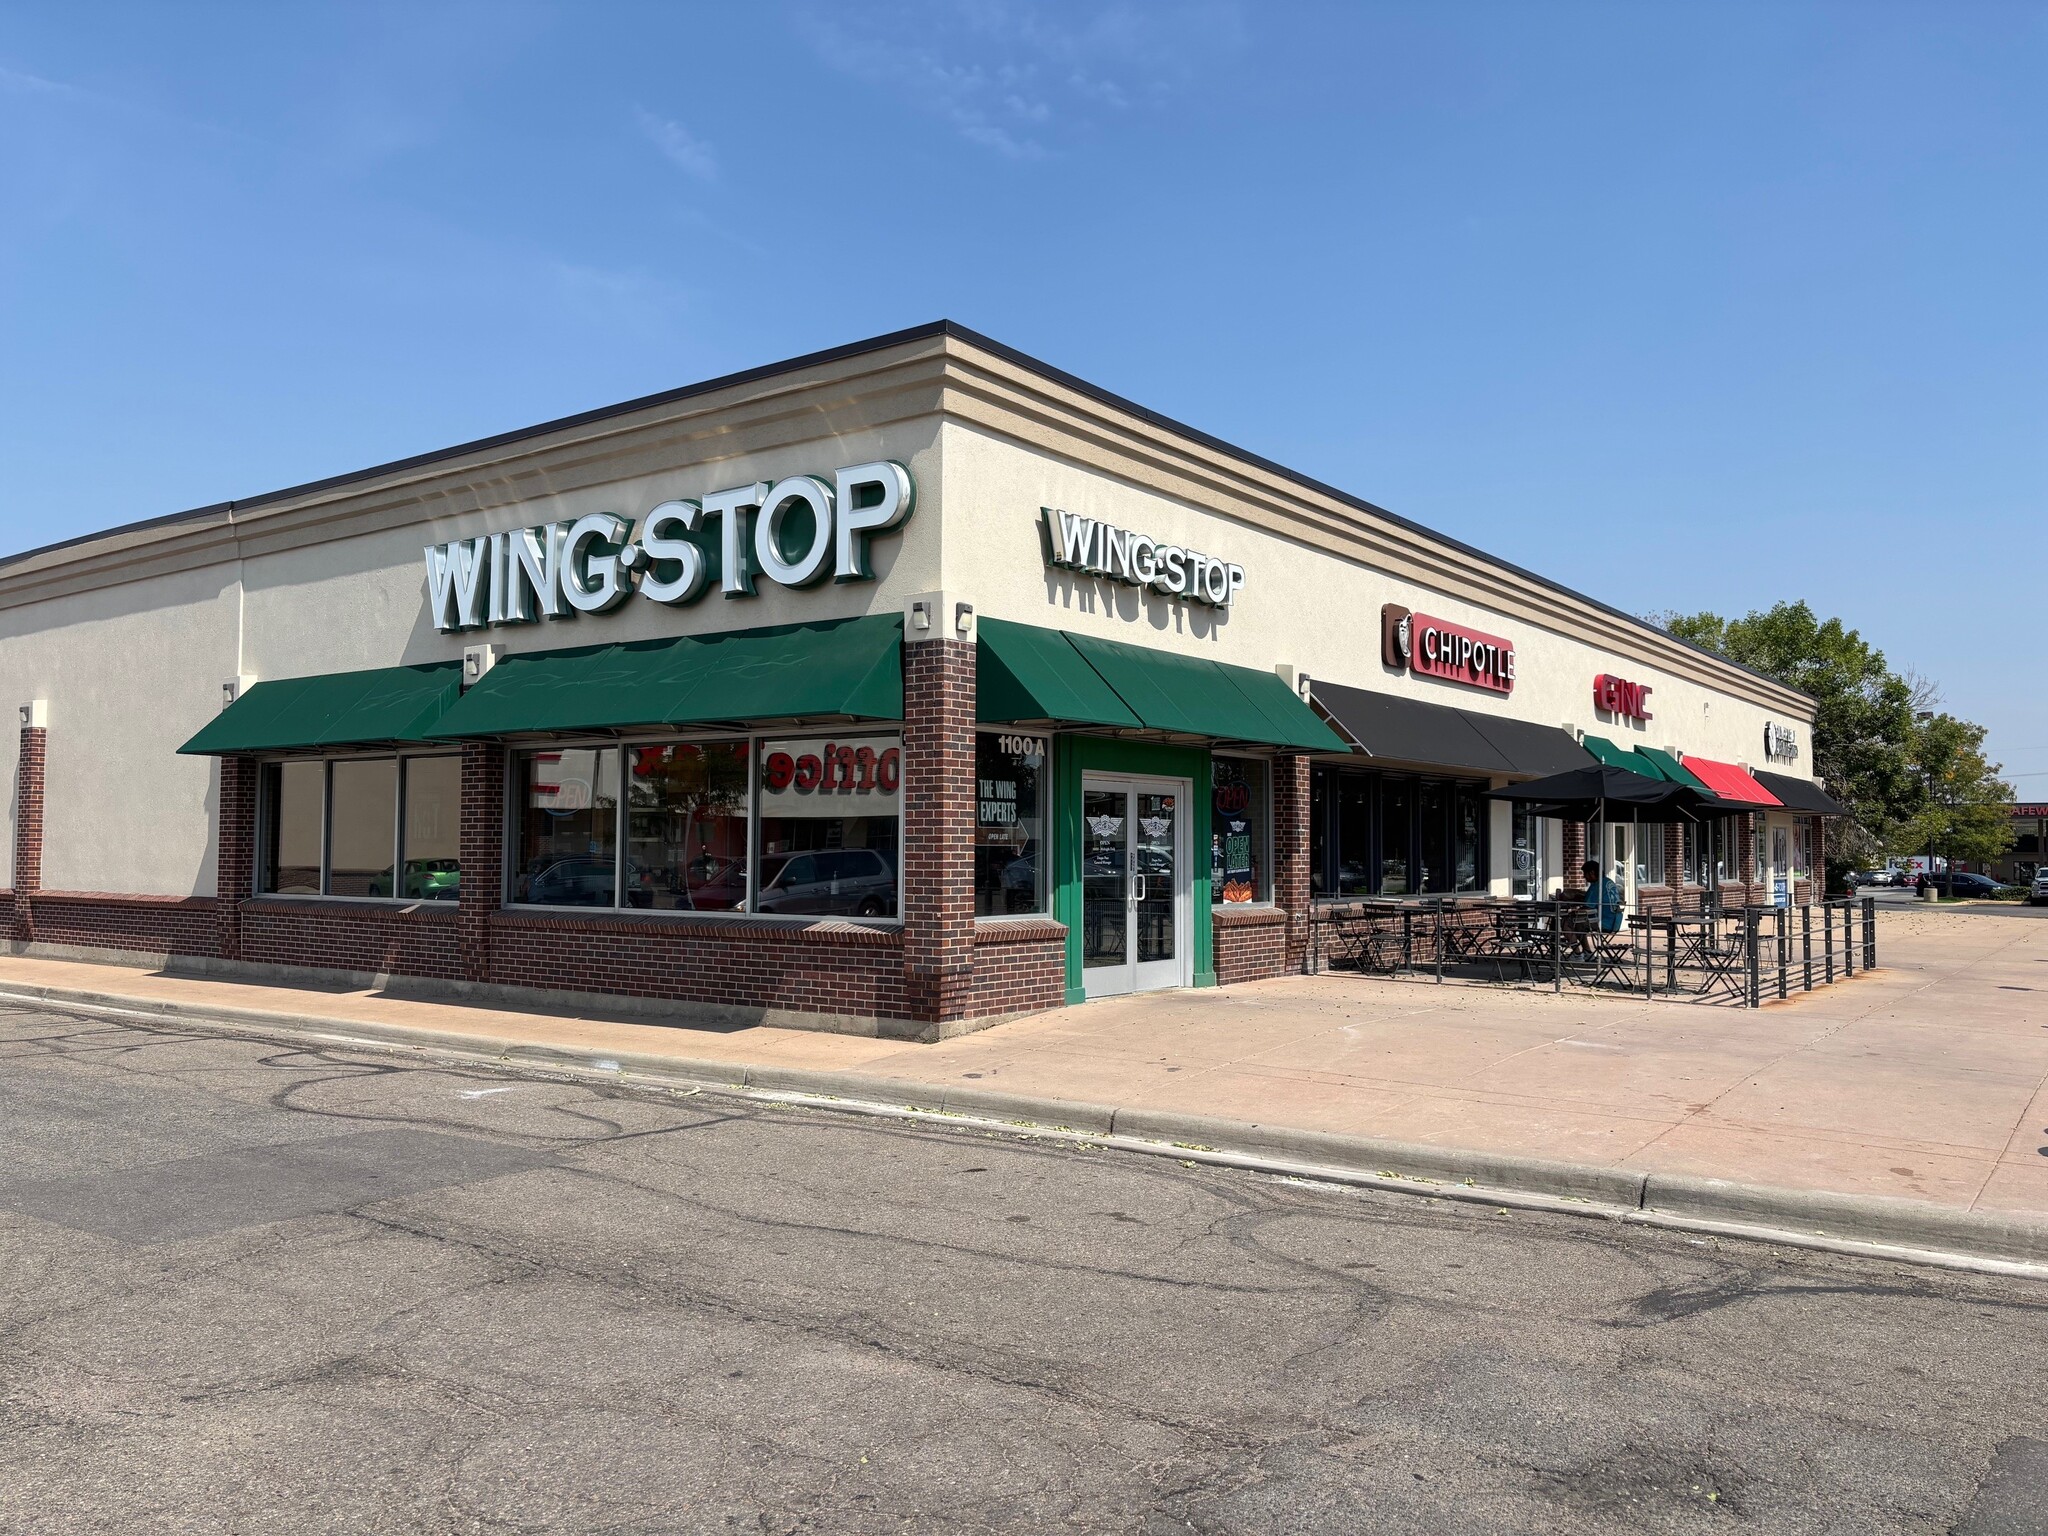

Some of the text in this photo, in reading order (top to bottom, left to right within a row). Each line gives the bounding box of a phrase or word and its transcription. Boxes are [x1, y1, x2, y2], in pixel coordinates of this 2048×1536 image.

[1425, 627, 1515, 680] CHIPOTLE
[1595, 674, 1653, 720] GNC
[545, 784, 587, 809] OPEN
[979, 779, 1017, 799] THE WING
[1216, 785, 1249, 809] OPEN
[980, 801, 1017, 822] EXPERTS
[2004, 805, 2048, 816] AFEW
[1226, 836, 1250, 855] OPEN
[1227, 853, 1250, 870] LATER
